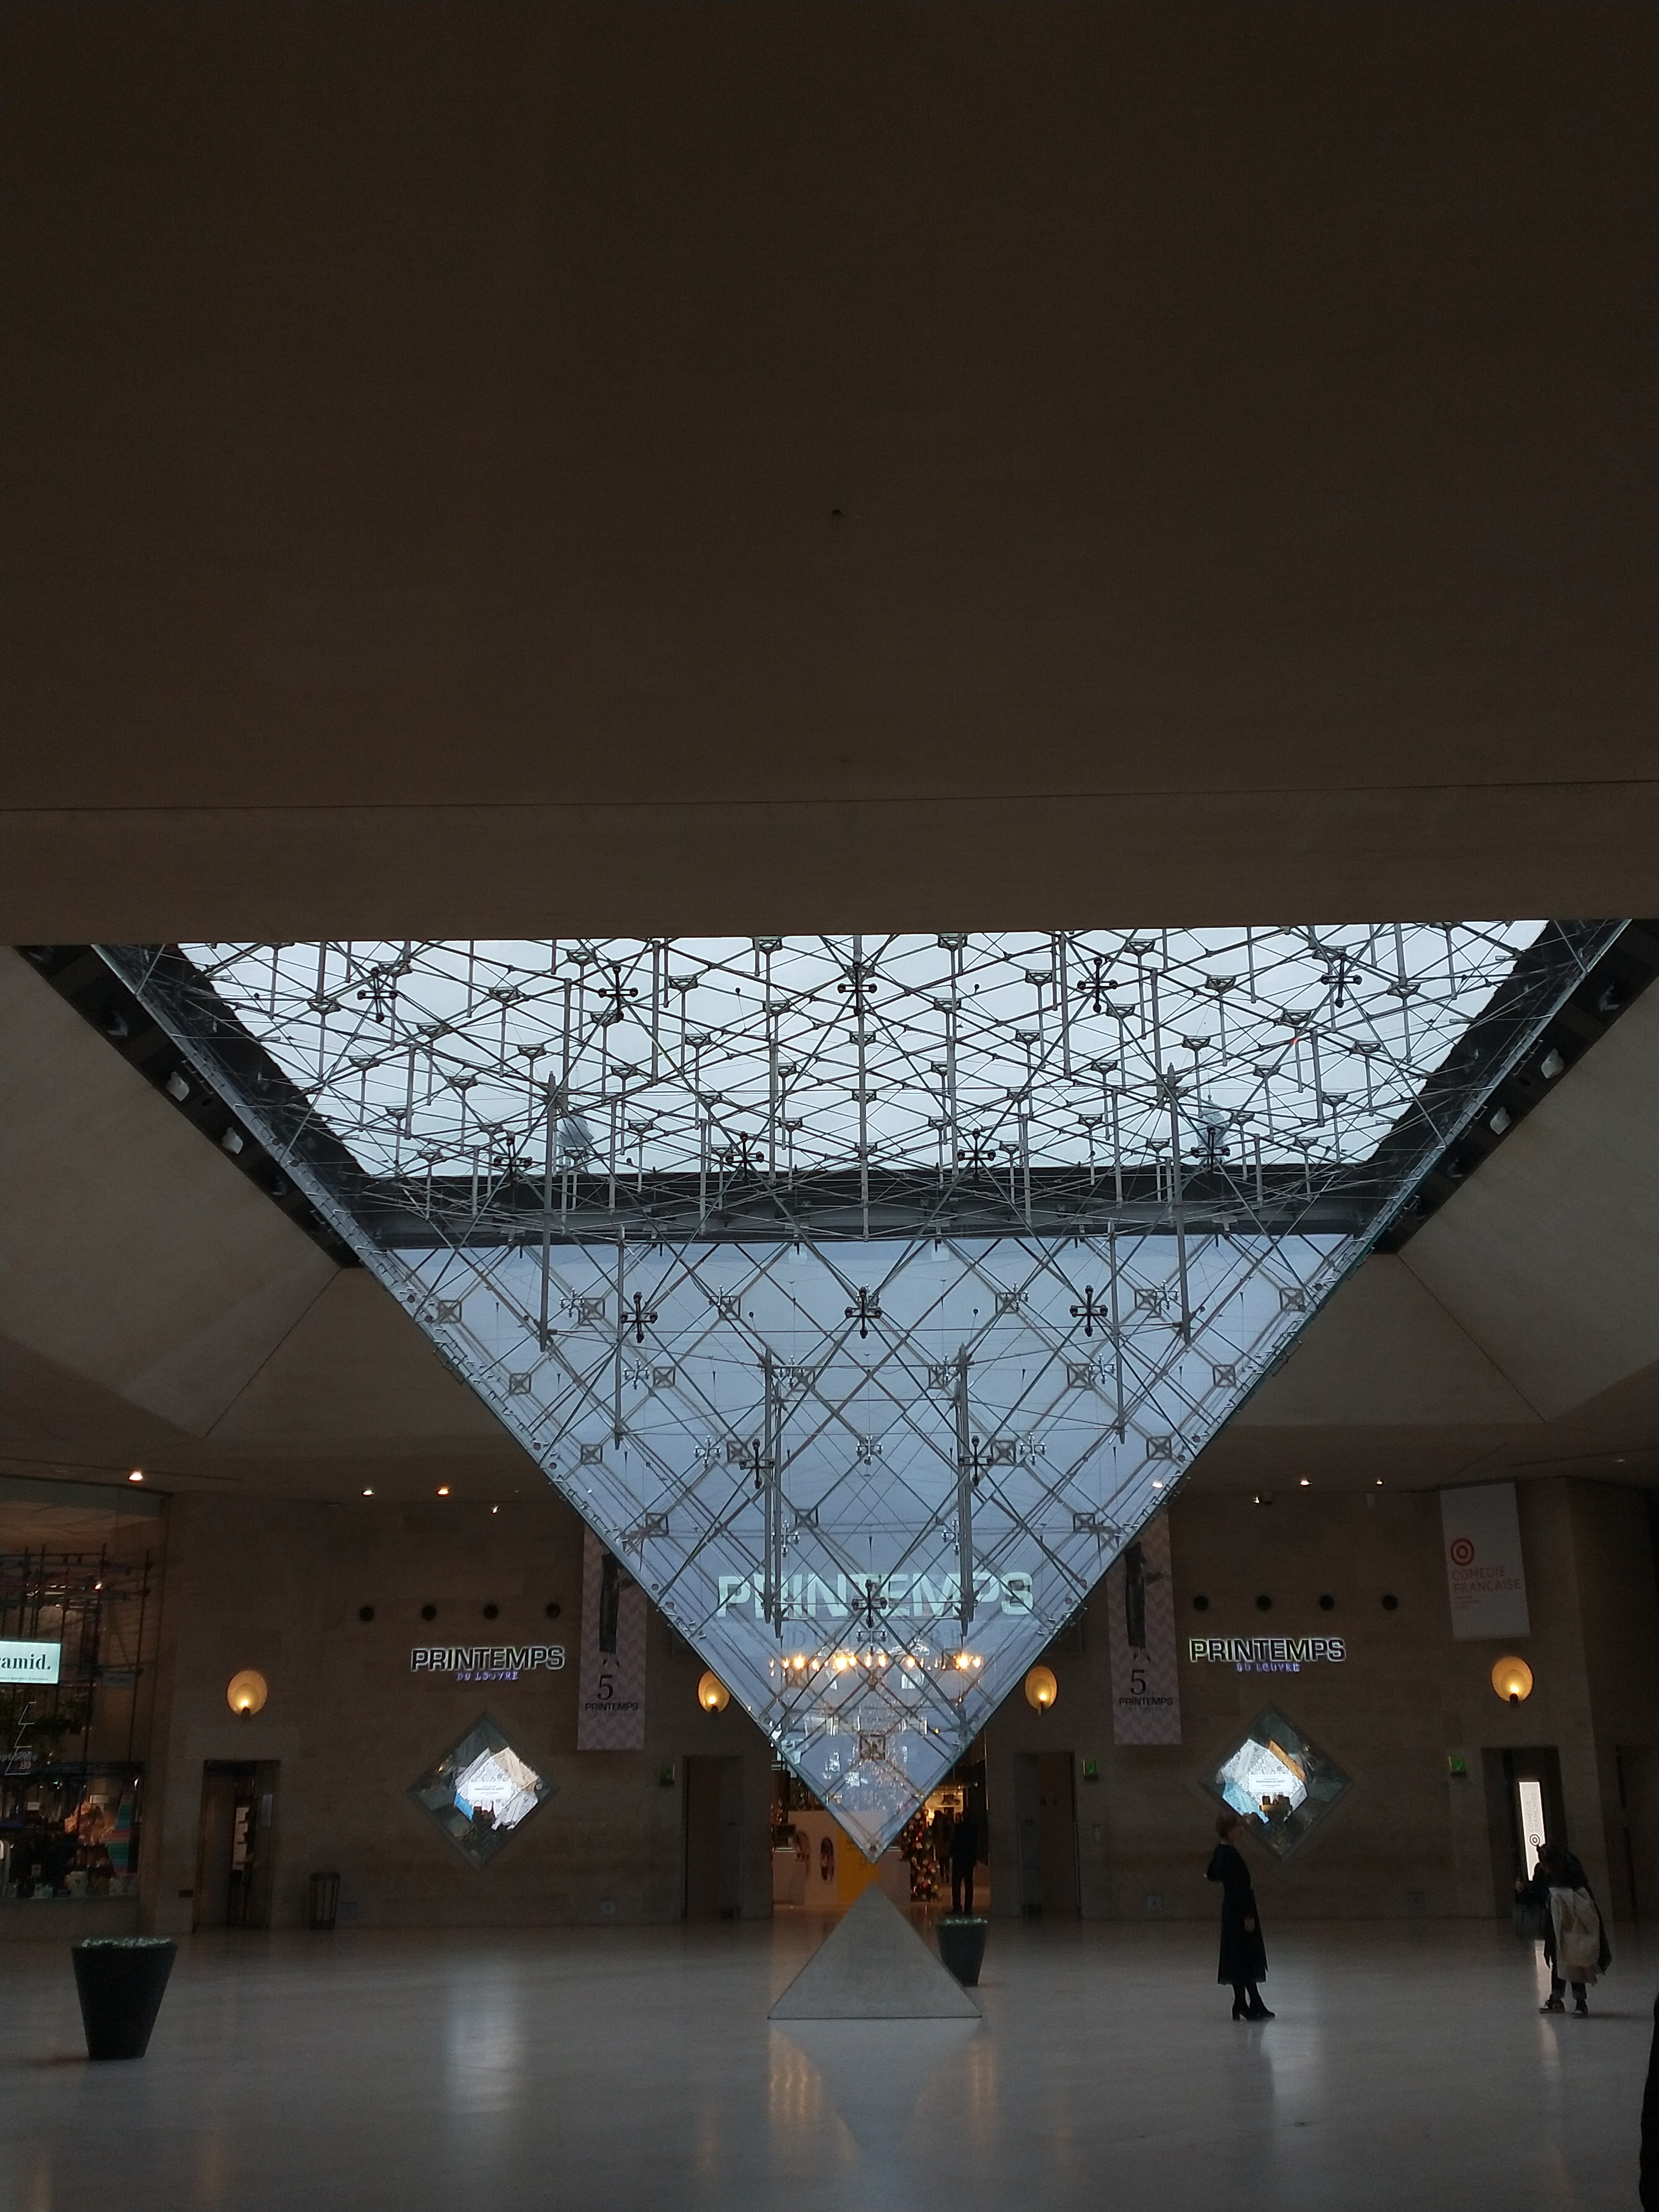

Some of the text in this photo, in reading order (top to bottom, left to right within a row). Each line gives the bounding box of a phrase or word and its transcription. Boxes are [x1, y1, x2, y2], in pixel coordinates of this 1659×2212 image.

[0, 1653, 51, 1670] amid.
[411, 1646, 565, 1672] PRINTEMPS
[1189, 1637, 1346, 1662] PRINTEMPS
[597, 1675, 613, 1700] 5
[1130, 1669, 1146, 1695] 5
[585, 1703, 638, 1711] PRINTEMPS
[1119, 1697, 1173, 1706] PRINTEMPS
